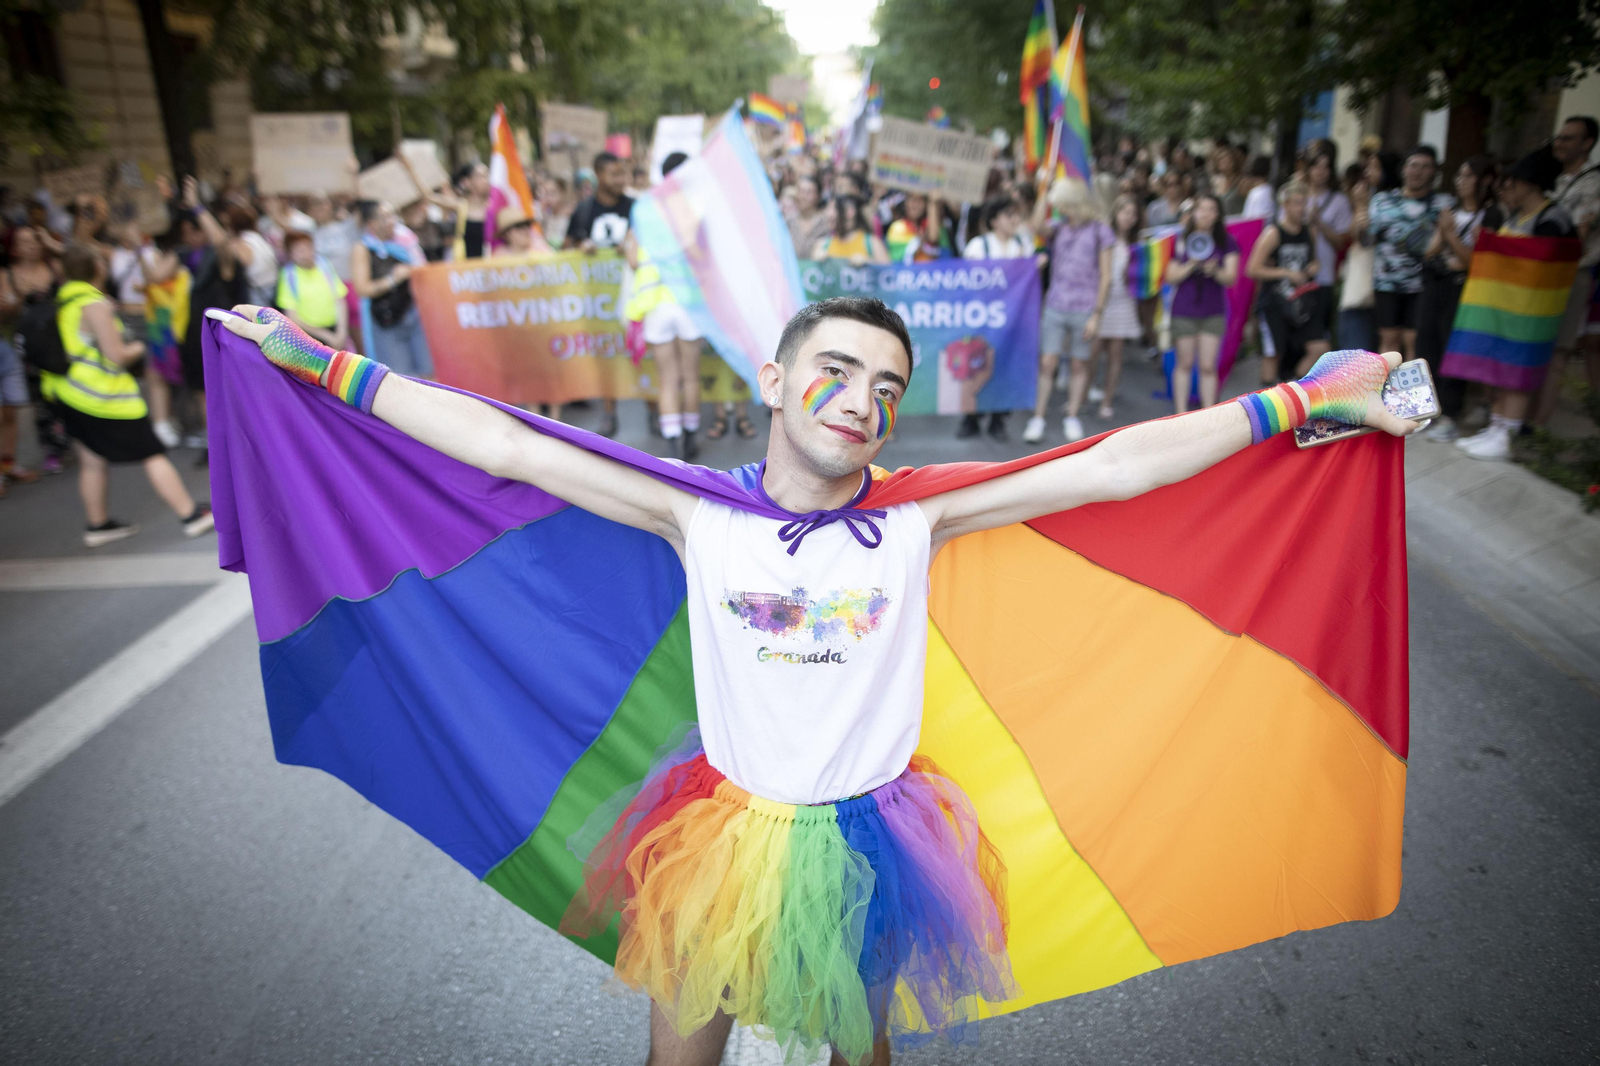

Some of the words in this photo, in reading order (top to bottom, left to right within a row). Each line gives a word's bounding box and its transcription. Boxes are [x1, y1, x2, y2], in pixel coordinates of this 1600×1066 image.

[449, 262, 578, 293] MEMORIA
[840, 267, 874, 291] DE
[879, 266, 1008, 290] GRANADA
[888, 300, 1007, 328] ARRIOS
[757, 647, 848, 664] Granada
